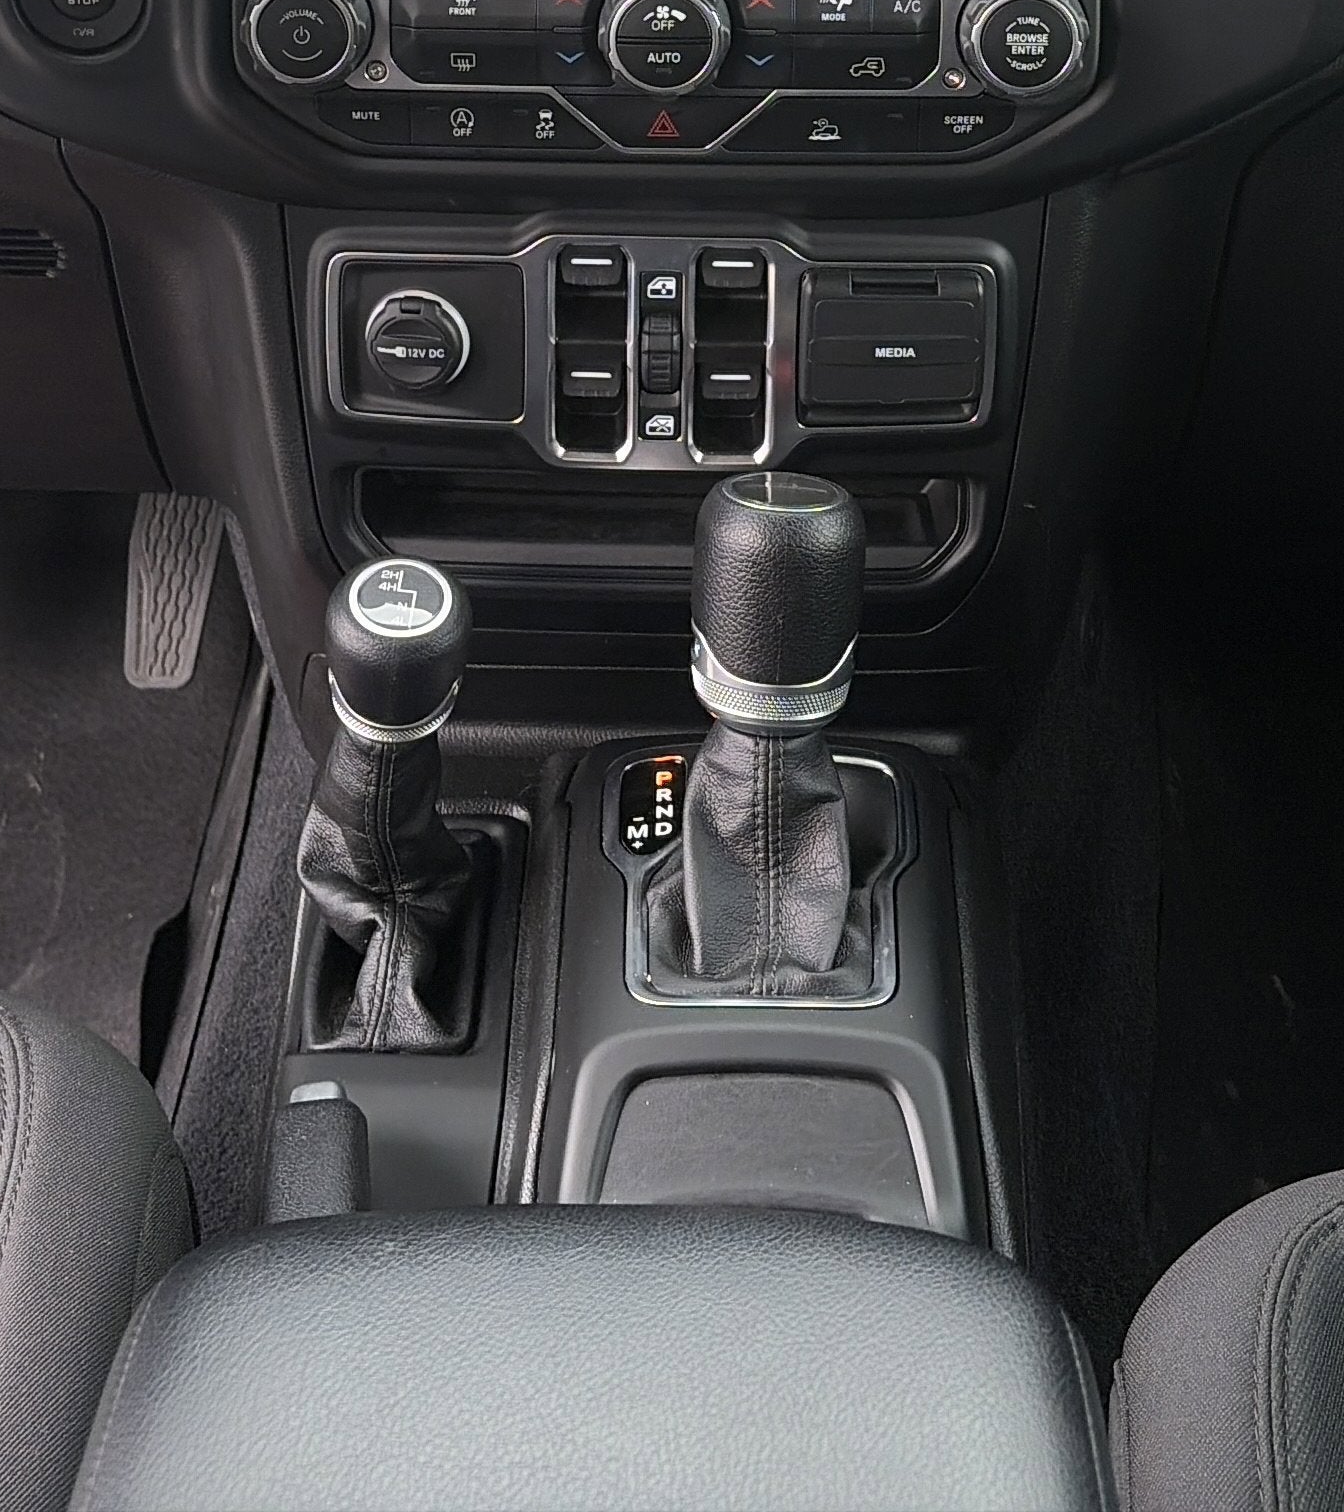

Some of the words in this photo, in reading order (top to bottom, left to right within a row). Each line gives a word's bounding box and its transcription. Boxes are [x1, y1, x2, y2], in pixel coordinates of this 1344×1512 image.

[448, 6, 476, 16] FRONT
[893, 0, 922, 14] A/C
[282, 9, 319, 22] VOLUME
[821, 12, 846, 22] MODE
[651, 20, 675, 31] OFF
[1016, 16, 1041, 27] TUNE
[1006, 33, 1049, 43] BROWSE
[1011, 45, 1045, 55] ENTER
[647, 52, 681, 64] AUTO
[1010, 60, 1043, 72] SCROLL
[352, 110, 380, 121] MUTE
[944, 115, 984, 125] SCREEN
[452, 128, 473, 137] OFF
[535, 130, 555, 139] OFF
[953, 125, 973, 134] OFF
[407, 348, 426, 358] 12V
[428, 348, 445, 359] DC
[874, 347, 916, 358] MEDIA
[380, 569, 400, 580] 2H
[378, 581, 397, 592] 4H
[656, 770, 673, 786] P
[656, 788, 673, 802] R
[655, 804, 674, 819] N
[627, 823, 649, 840] M
[655, 821, 673, 836] D
